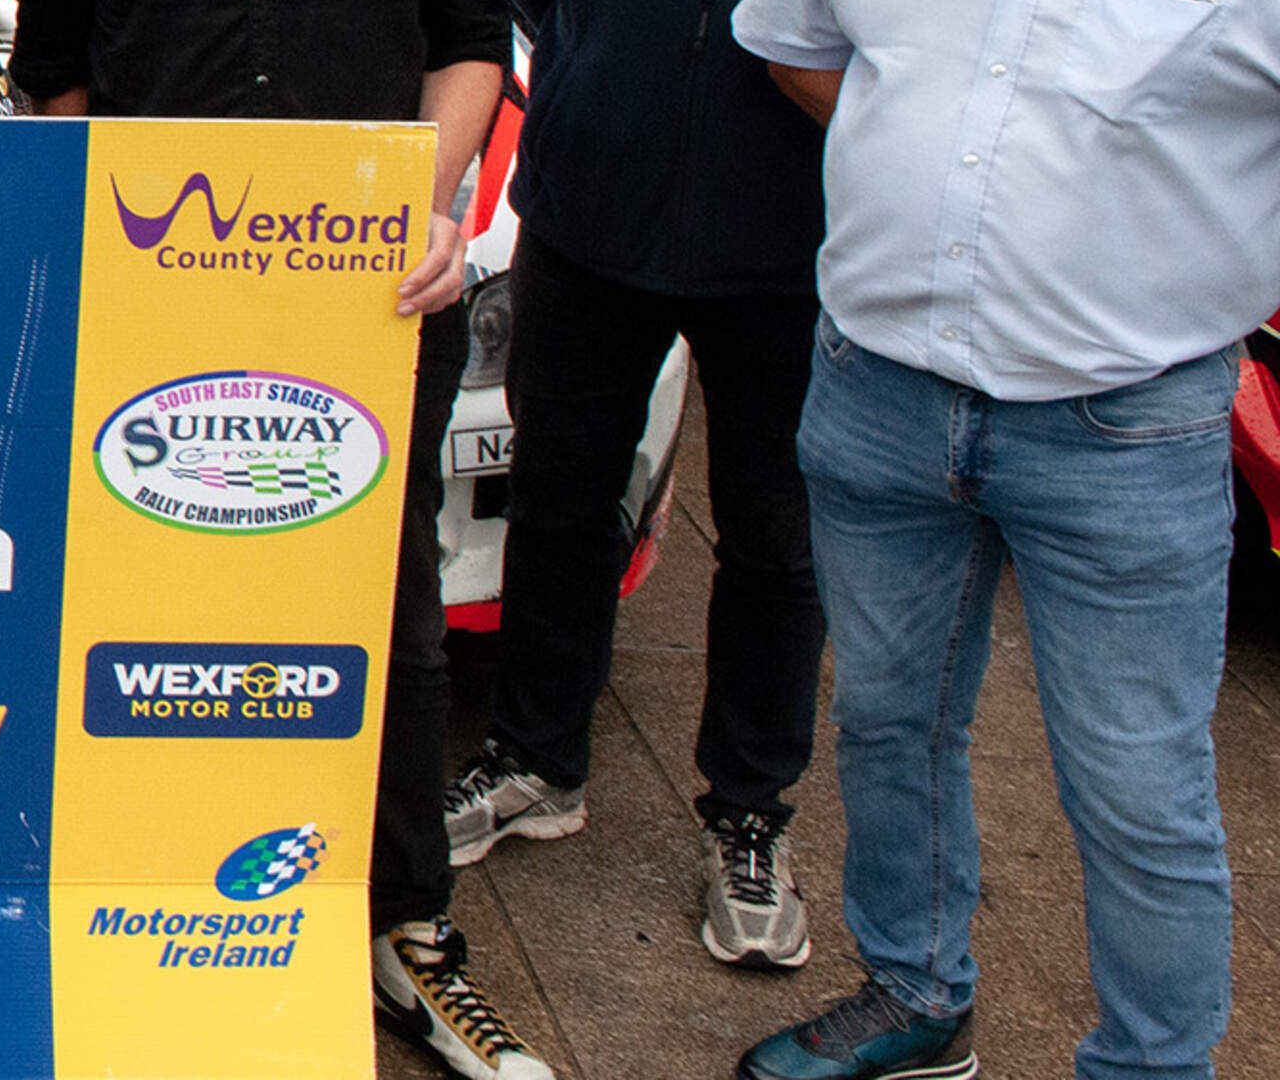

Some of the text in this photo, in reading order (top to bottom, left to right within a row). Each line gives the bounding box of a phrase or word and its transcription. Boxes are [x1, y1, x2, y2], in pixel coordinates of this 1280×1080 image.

[110, 172, 410, 250] Wexford
[157, 246, 407, 276] County Council
[155, 381, 335, 415] SOUTH EAST STAGES
[122, 415, 355, 470] SUIRWAY
[134, 486, 319, 526] RALLY CHAMPIONSHIP
[113, 662, 341, 699] WEXFORD
[130, 700, 314, 719] MOTOR CLUB
[88, 907, 305, 942] Motorsport
[158, 939, 296, 968] Ireland
